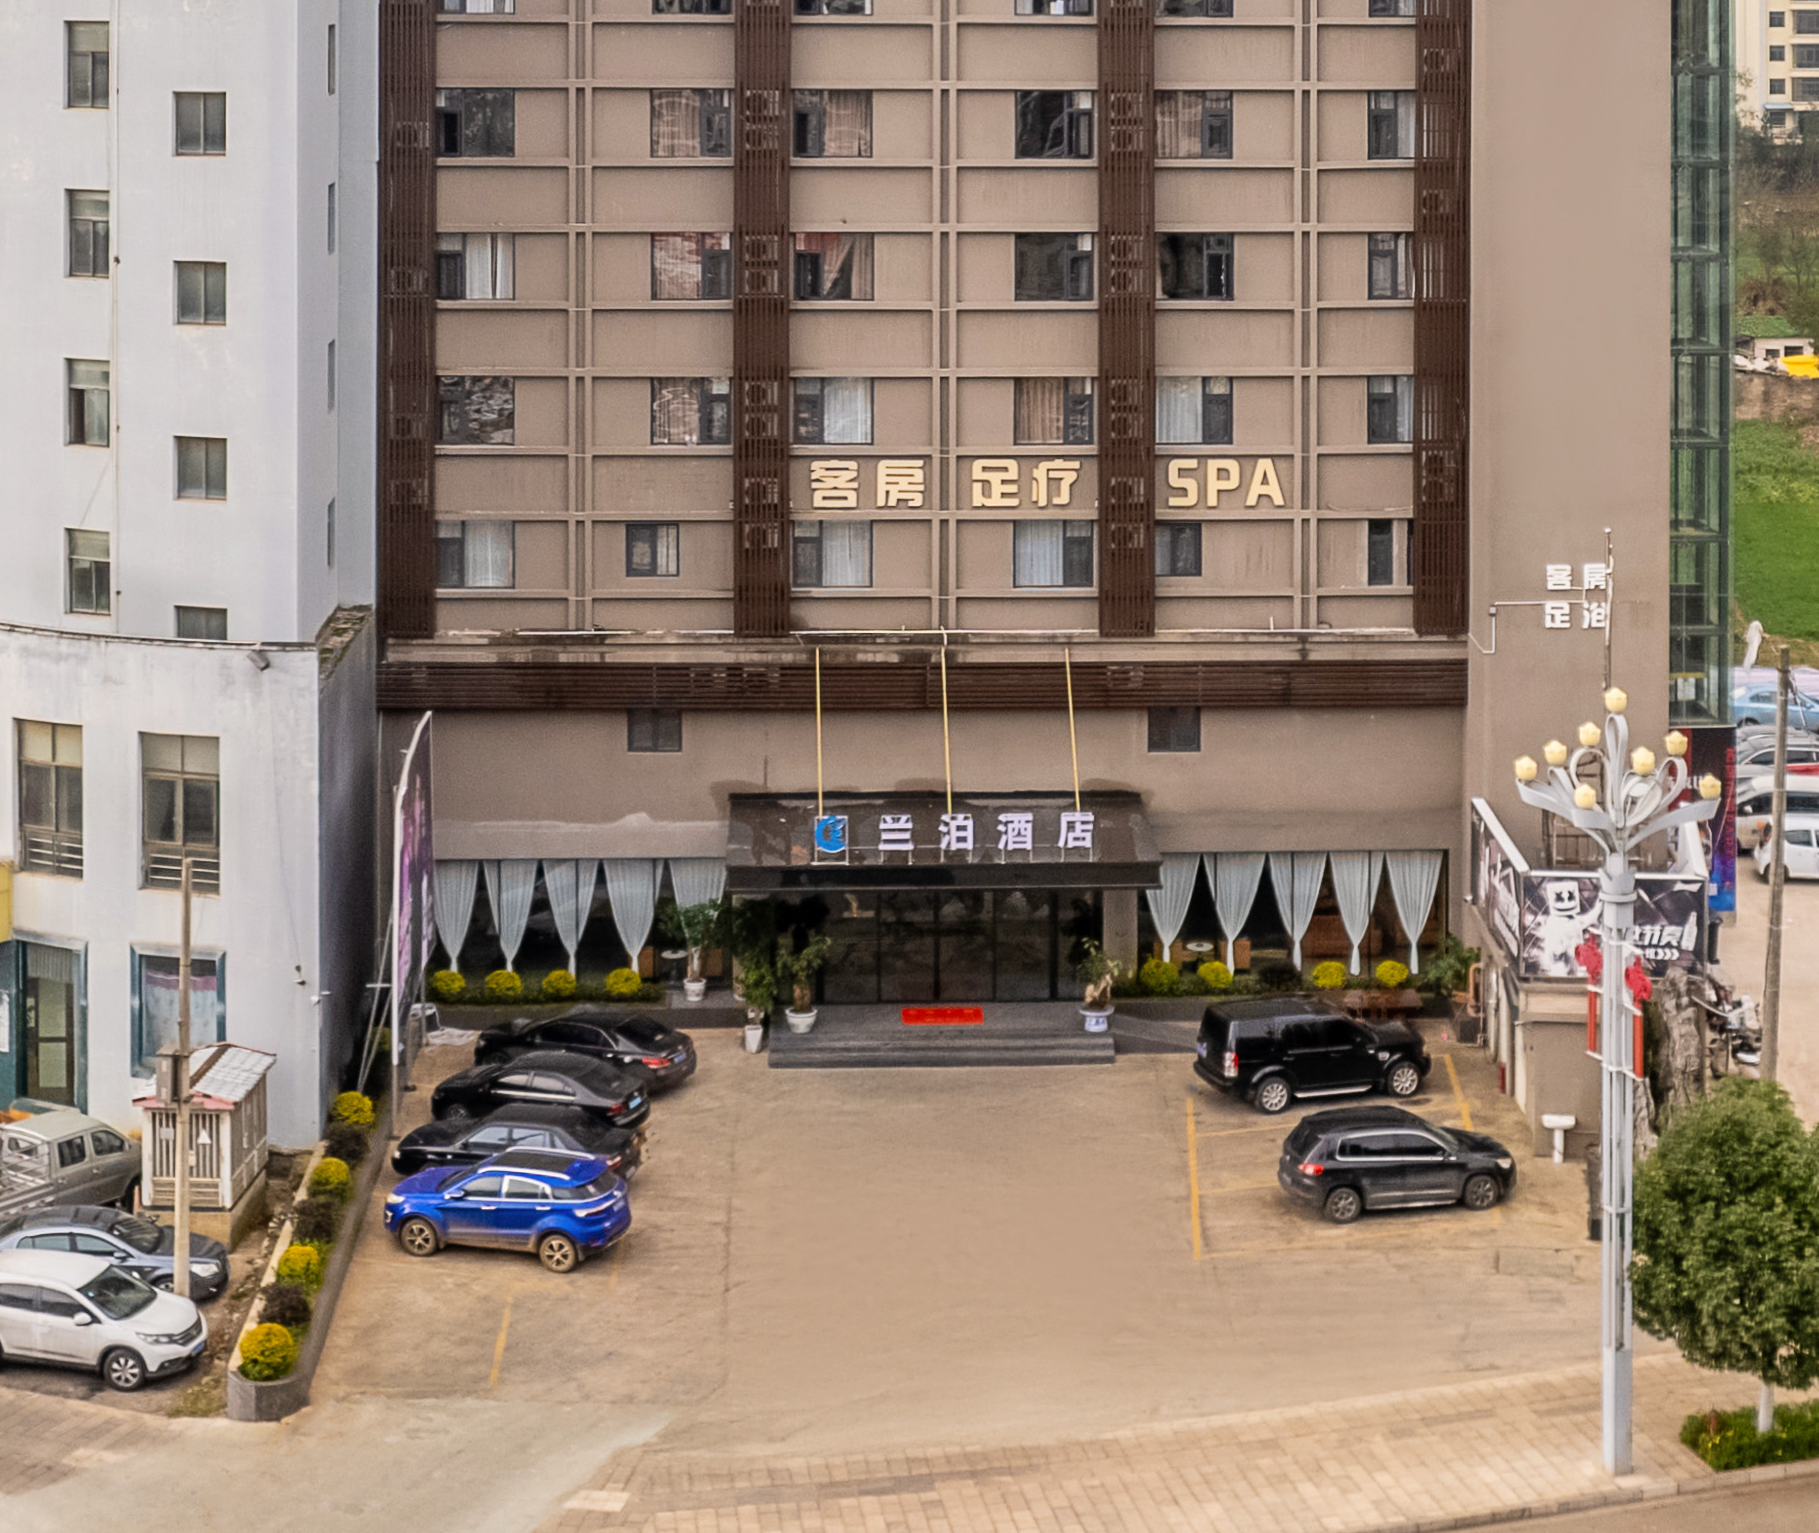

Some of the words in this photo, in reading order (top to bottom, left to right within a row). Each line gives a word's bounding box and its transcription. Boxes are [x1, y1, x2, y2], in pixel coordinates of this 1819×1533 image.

[810, 459, 925, 508] 客房
[971, 458, 1081, 508] 足疗
[1167, 457, 1286, 508] SPA
[1546, 563, 1607, 591] 客房
[878, 812, 1095, 851] 兰泊酒店
